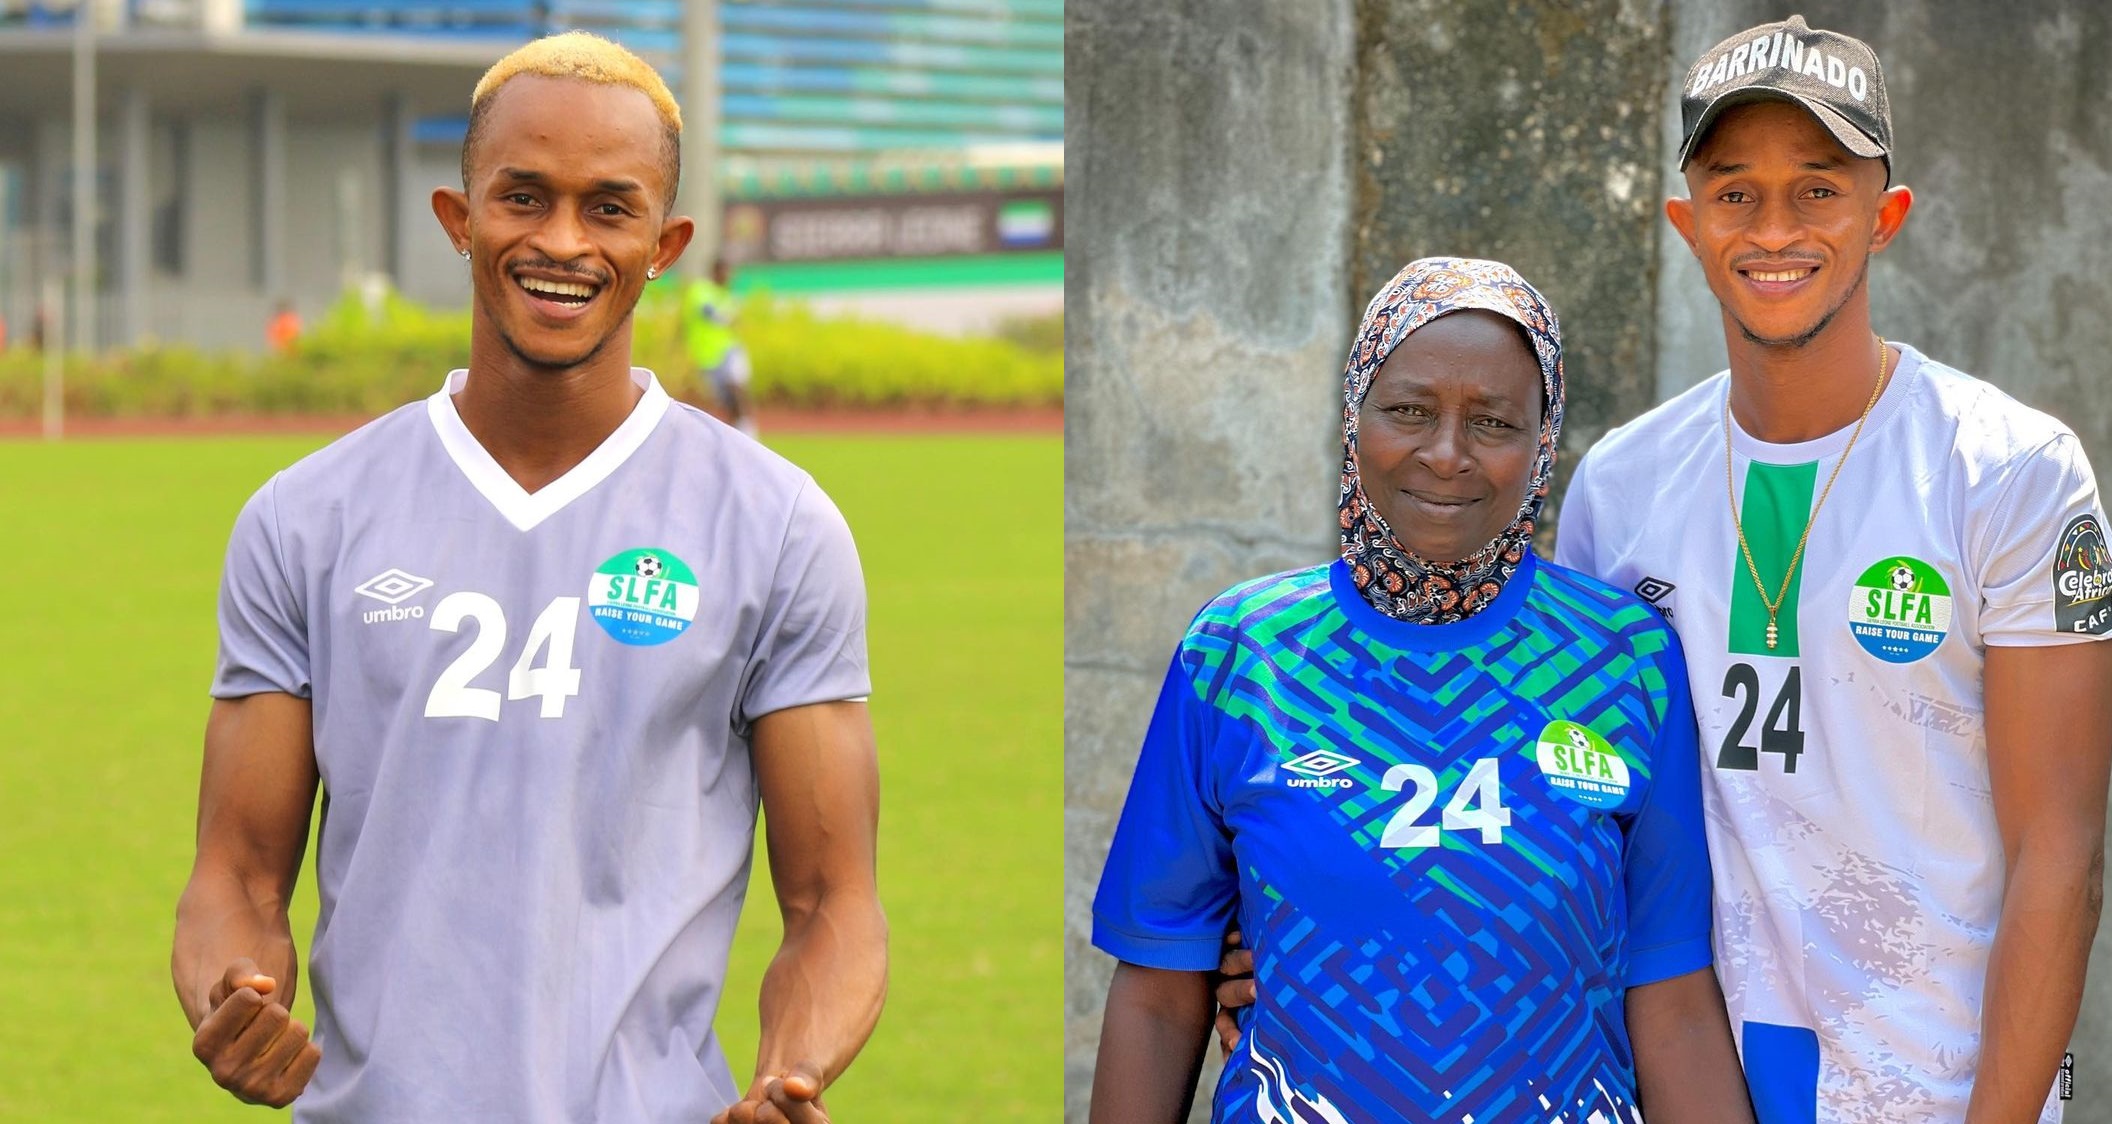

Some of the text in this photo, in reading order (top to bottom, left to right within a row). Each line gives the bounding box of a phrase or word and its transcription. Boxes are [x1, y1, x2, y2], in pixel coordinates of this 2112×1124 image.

[1689, 32, 1868, 101] BARRINADO
[607, 576, 677, 611] SLFA
[1866, 589, 1931, 624] SLFA
[363, 604, 425, 625] umbro
[595, 607, 623, 620] RAISE
[626, 611, 653, 625] YOUR
[655, 616, 683, 631] GAME
[1855, 625, 1939, 644] RAISE YOUR GAME
[424, 591, 582, 722] 24
[1716, 662, 1805, 774] 24
[1553, 745, 1614, 779] SLFA
[1287, 777, 1354, 789] umbro
[1577, 780, 1600, 792] YOUR
[1380, 758, 1511, 848] 24
